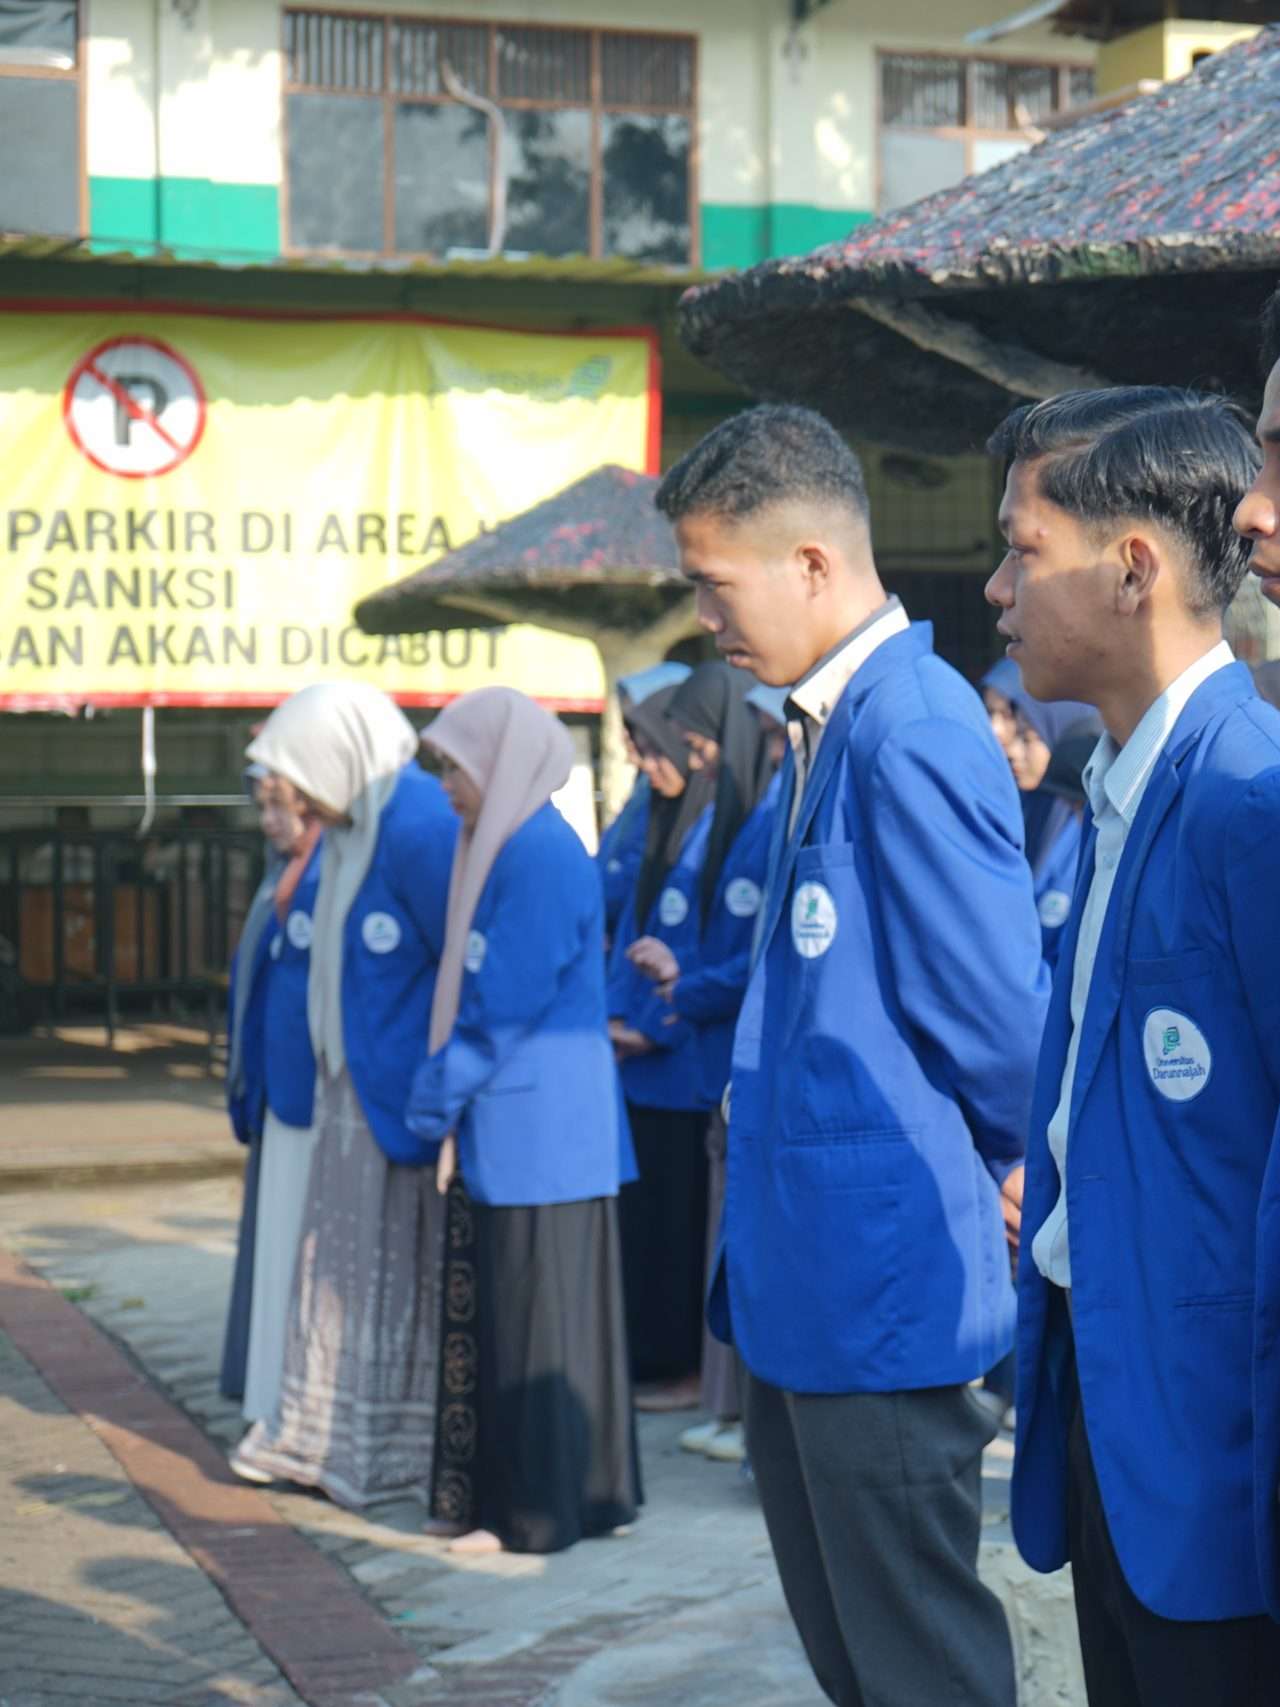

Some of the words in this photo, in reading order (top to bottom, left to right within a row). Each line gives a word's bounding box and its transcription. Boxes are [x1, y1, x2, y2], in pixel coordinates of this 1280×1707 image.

[7, 508, 216, 553] PARKIR
[241, 511, 291, 553] DI
[316, 513, 452, 555] AREA
[26, 567, 233, 610] SANKSI
[0, 624, 84, 667] AN
[107, 624, 257, 666] AKAN
[280, 625, 505, 669] DICABUT
